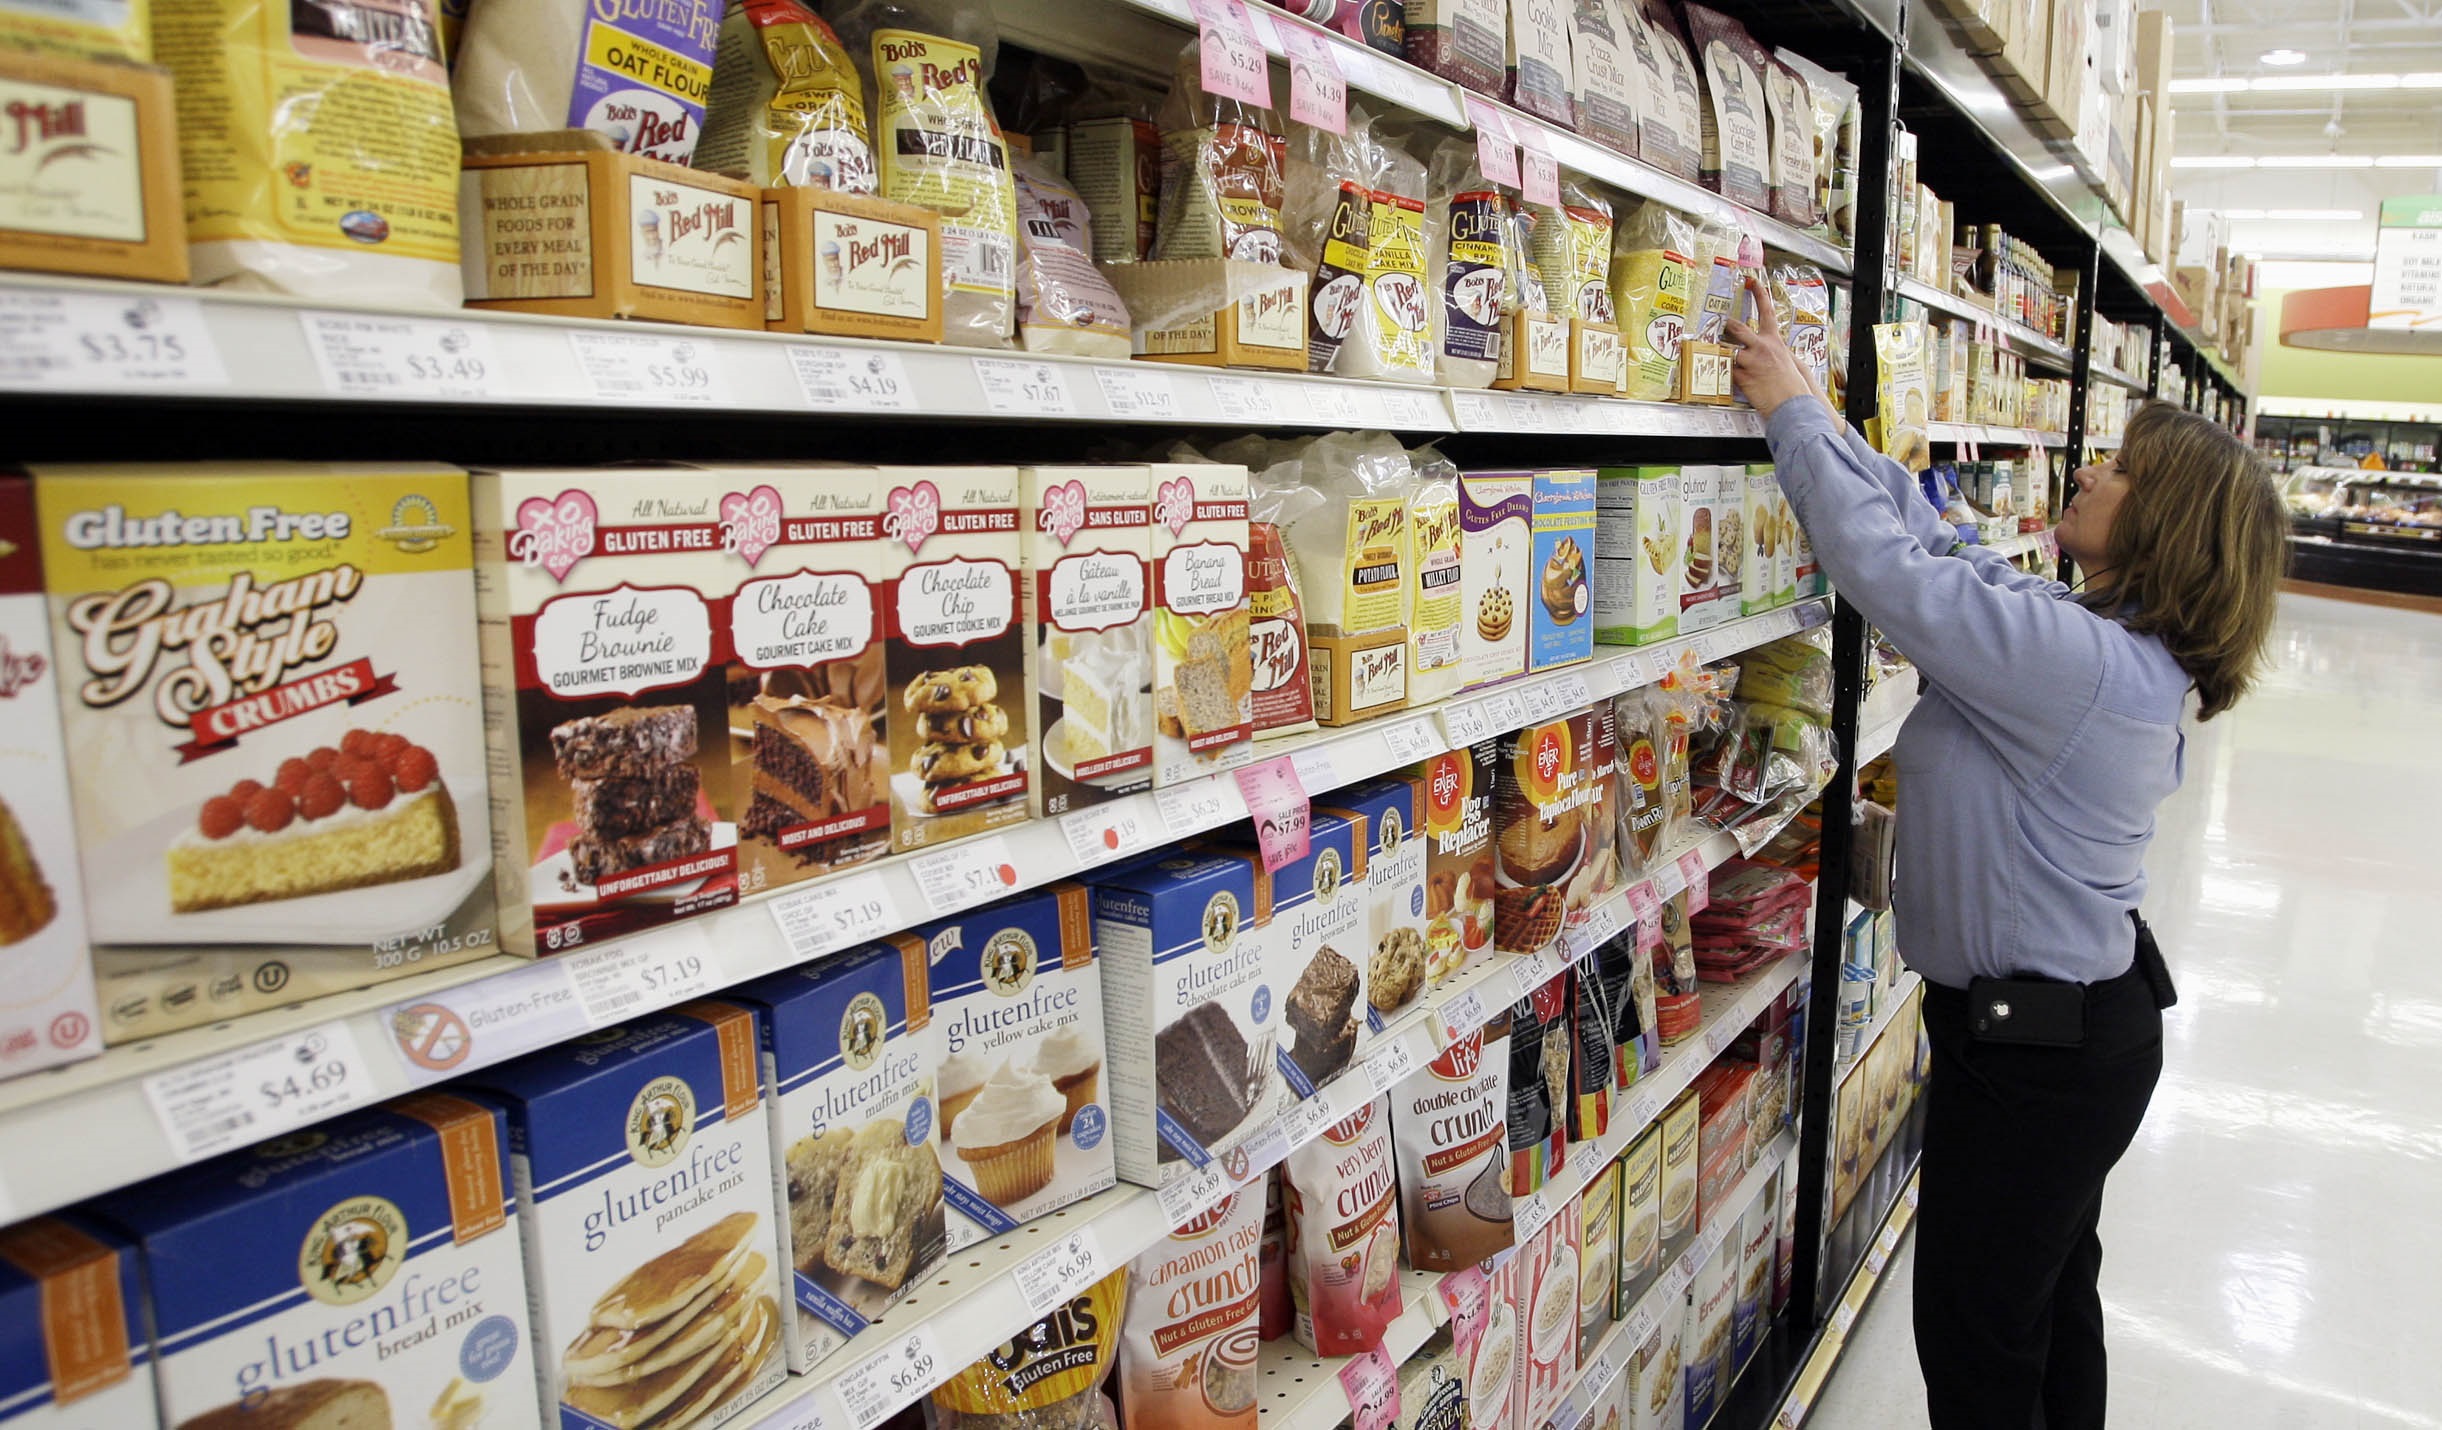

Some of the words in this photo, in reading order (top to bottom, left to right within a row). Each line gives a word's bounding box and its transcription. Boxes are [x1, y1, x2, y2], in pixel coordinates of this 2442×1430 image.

[630, 40, 668, 64] WHOLE
[669, 58, 699, 75] GRAIN
[881, 41, 928, 63] Bob's
[1230, 50, 1262, 74] $5.29
[607, 47, 650, 78] OAT
[653, 66, 711, 101] FLOUR
[921, 61, 968, 99] Red
[1208, 68, 1232, 86] SAVE
[1315, 84, 1342, 103] $4.39
[606, 103, 637, 121] Bob's
[633, 110, 690, 153] Red
[485, 197, 535, 212] WHOLE
[539, 194, 585, 210] GRAIN
[496, 219, 543, 233] FOODS
[546, 217, 575, 232] FOR
[669, 206, 701, 247] Red
[702, 202, 735, 241] Mill
[495, 241, 538, 256] EVERY
[542, 239, 582, 254] MEAL
[848, 240, 879, 272] Red
[880, 230, 911, 266] Mill
[498, 264, 518, 278] OF
[521, 263, 548, 277] THE
[1661, 302, 1680, 313] CORN
[79, 332, 186, 363] $3.75
[1153, 331, 1167, 340] OF
[1168, 330, 1188, 340] THE
[407, 354, 486, 381] $3.49
[648, 365, 709, 388] $5.99
[848, 375, 897, 395] $4.19
[632, 499, 655, 518] All
[656, 499, 709, 517] Natural
[728, 495, 771, 517] XO
[810, 494, 828, 511] All
[829, 493, 872, 511] Natural
[962, 489, 977, 504] All
[978, 489, 1013, 504] Natural
[1196, 506, 1223, 520] GLUTEN
[1224, 504, 1245, 518] FREE
[65, 504, 245, 549] Gluten
[247, 506, 351, 543] Free
[528, 501, 583, 530] XO
[788, 522, 841, 542] GLUTEN
[842, 520, 875, 538] FREE
[944, 513, 987, 532] GLUTEN
[988, 511, 1015, 529] FREE
[1088, 510, 1113, 526] SANS
[1113, 507, 1147, 524] GLUTEN
[510, 516, 595, 568] Baking
[604, 532, 671, 552] GLUTEN
[672, 529, 713, 549] FREE
[720, 508, 781, 556] Baking
[1080, 558, 1121, 581] Gâteau
[1185, 551, 1226, 572] Banana
[921, 567, 993, 595] Chocolate
[1190, 570, 1222, 592] Bread
[758, 580, 849, 615] Chocolate
[941, 592, 975, 619] Chip
[1175, 594, 1205, 607] GOURMET
[1205, 592, 1223, 605] BREAD
[593, 598, 659, 635] Fudge
[782, 610, 829, 641] Cake
[913, 621, 955, 638] GOURMET
[956, 619, 984, 633] COOKIE
[984, 616, 1001, 630] MIX
[69, 562, 365, 710] Graham
[580, 631, 675, 663] Brownie
[756, 641, 805, 661] GOURMET
[807, 638, 834, 655] CAKE
[835, 636, 853, 651] MIX
[156, 612, 339, 728] Style
[553, 667, 616, 689] GOURMET
[619, 660, 673, 681] BROWNIE
[676, 656, 699, 672] MIX
[209, 665, 362, 737] CRUMBS
[1460, 719, 1484, 738] $3.49
[1557, 769, 1579, 793] Pure
[1278, 808, 1292, 820] SALE
[1292, 804, 1309, 818] PRICE
[1461, 795, 1484, 826] Egg
[1538, 790, 1571, 825] Tapioca
[781, 830, 807, 846] MOIST
[807, 825, 824, 841] AND
[824, 815, 867, 838] DELICIOUS!
[1278, 815, 1306, 836] $7.99
[1438, 819, 1492, 857] Replacer
[598, 867, 678, 898] UNFORGETTABLY
[678, 853, 729, 877] DELICIOUS!
[832, 900, 883, 931] $7.19
[1291, 895, 1359, 951] glutenfree
[374, 934, 407, 954] NET
[416, 923, 447, 944] WT
[640, 955, 701, 992] $7.19
[1176, 942, 1263, 1007] glutenfree
[1186, 984, 1228, 1008] chocolate
[1229, 974, 1247, 991] cake
[1248, 966, 1262, 981] mix
[468, 987, 572, 1029] Gluten-Free
[947, 984, 1079, 1054] glutenfree
[983, 1028, 1025, 1055] yellow
[1027, 1016, 1054, 1036] cake
[1056, 1008, 1080, 1026] mix
[1387, 1052, 1409, 1074] $6.89
[259, 1060, 347, 1109] $4.69
[810, 1050, 920, 1141] glutenfree
[864, 1091, 900, 1120] muffin
[901, 1079, 920, 1098] mix
[1306, 1102, 1331, 1126] $6.89
[1412, 1089, 1459, 1116] double
[1429, 1096, 1495, 1147] crunch
[1336, 1154, 1362, 1181] very
[1363, 1134, 1387, 1167] berry
[1430, 1156, 1447, 1169] Nut
[1447, 1153, 1455, 1163] &
[1454, 1143, 1478, 1161] Gluten
[583, 1140, 744, 1253] glutenfree
[655, 1186, 716, 1233] pancake
[717, 1170, 745, 1194] mix
[1191, 1172, 1221, 1201] $6.89
[1057, 1249, 1092, 1283] $6.99
[1166, 1254, 1258, 1319] crunch
[235, 1265, 482, 1413] glutenfree
[376, 1318, 438, 1363] bread
[445, 1300, 486, 1330] mix
[1159, 1328, 1178, 1346] Nut
[1179, 1326, 1187, 1337] &
[1188, 1314, 1224, 1335] Gluten
[1225, 1306, 1246, 1322] Free
[889, 1353, 934, 1394] $6.89
[1012, 1360, 1063, 1392] Gluten
[1064, 1350, 1094, 1370] Free
[1372, 1386, 1396, 1414] $4.99
